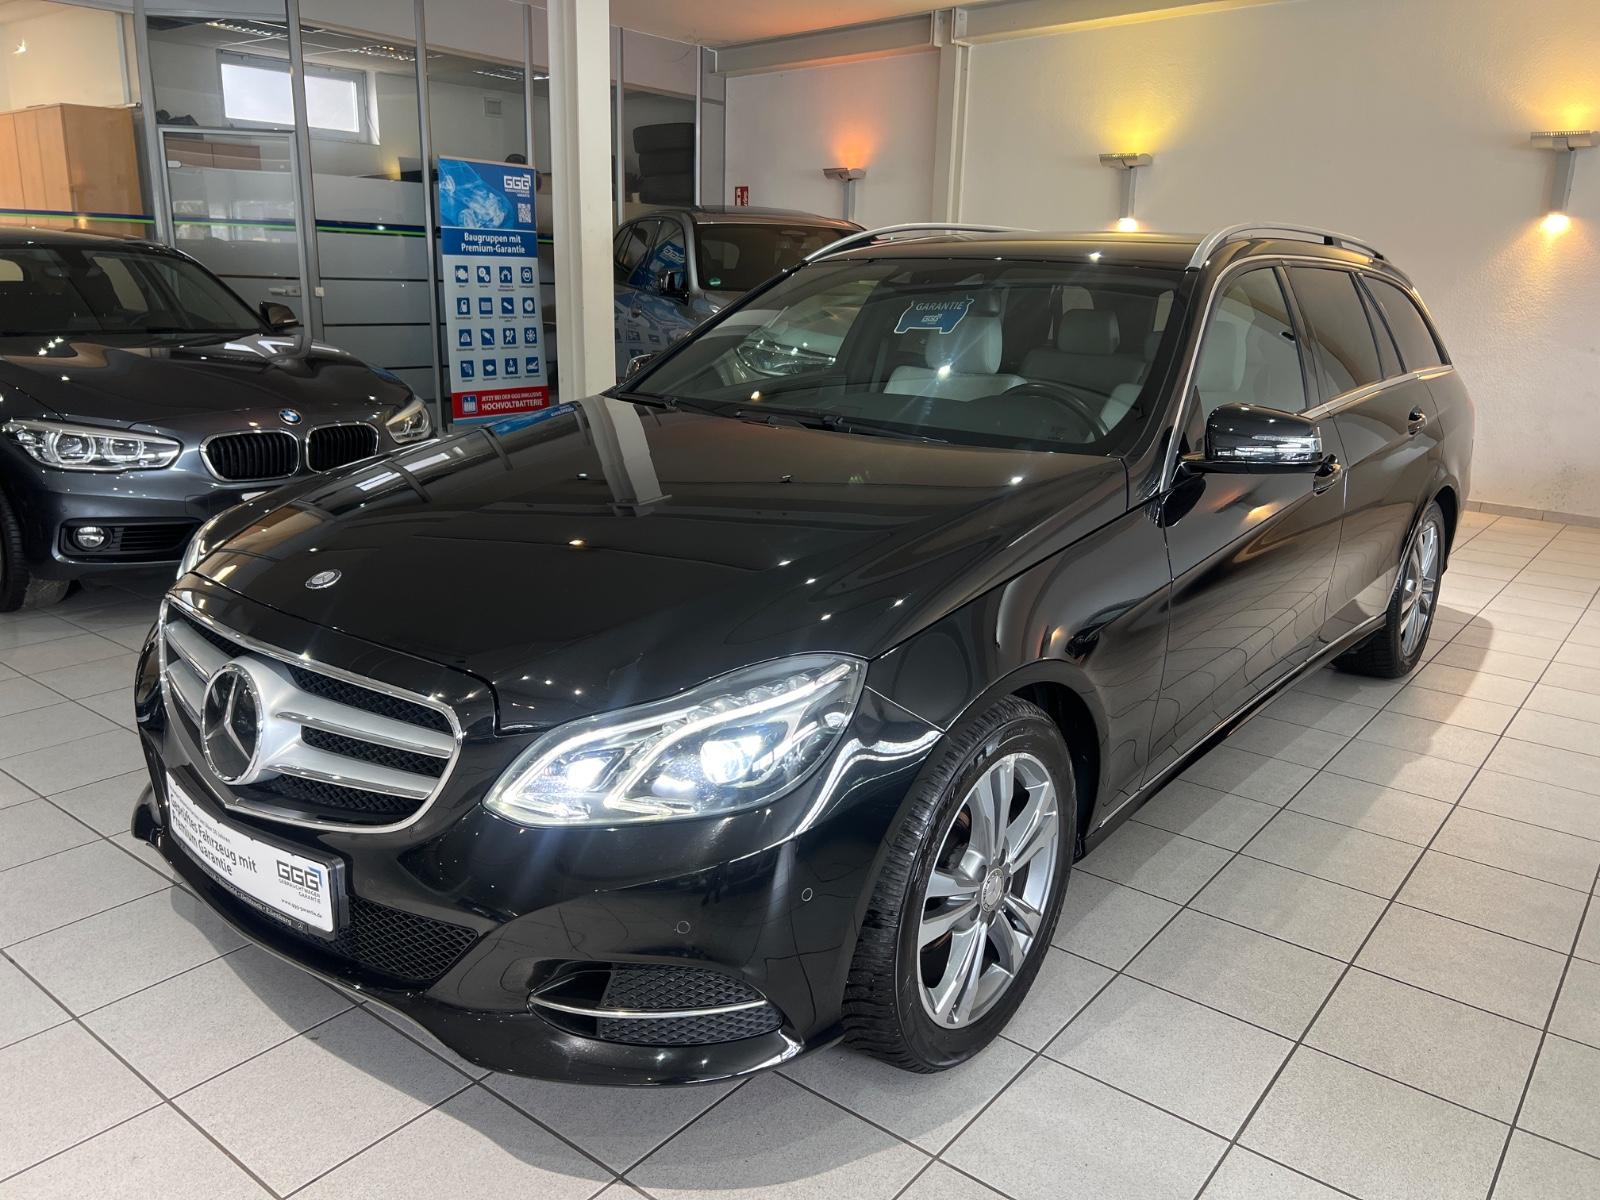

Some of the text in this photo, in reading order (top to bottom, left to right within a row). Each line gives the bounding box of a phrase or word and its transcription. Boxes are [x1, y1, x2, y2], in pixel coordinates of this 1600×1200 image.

[504, 175, 530, 190] GGG
[464, 232, 521, 244] Baugruppen mit
[461, 244, 526, 254] Premium-Garantie
[916, 302, 965, 311] GARANTIE
[482, 399, 543, 410] HOCHVOLTBATTERIE
[172, 810, 233, 876] Premium Garantie
[198, 824, 237, 865] Fahrzeug
[239, 854, 257, 873] mit
[276, 860, 320, 892] GGG
